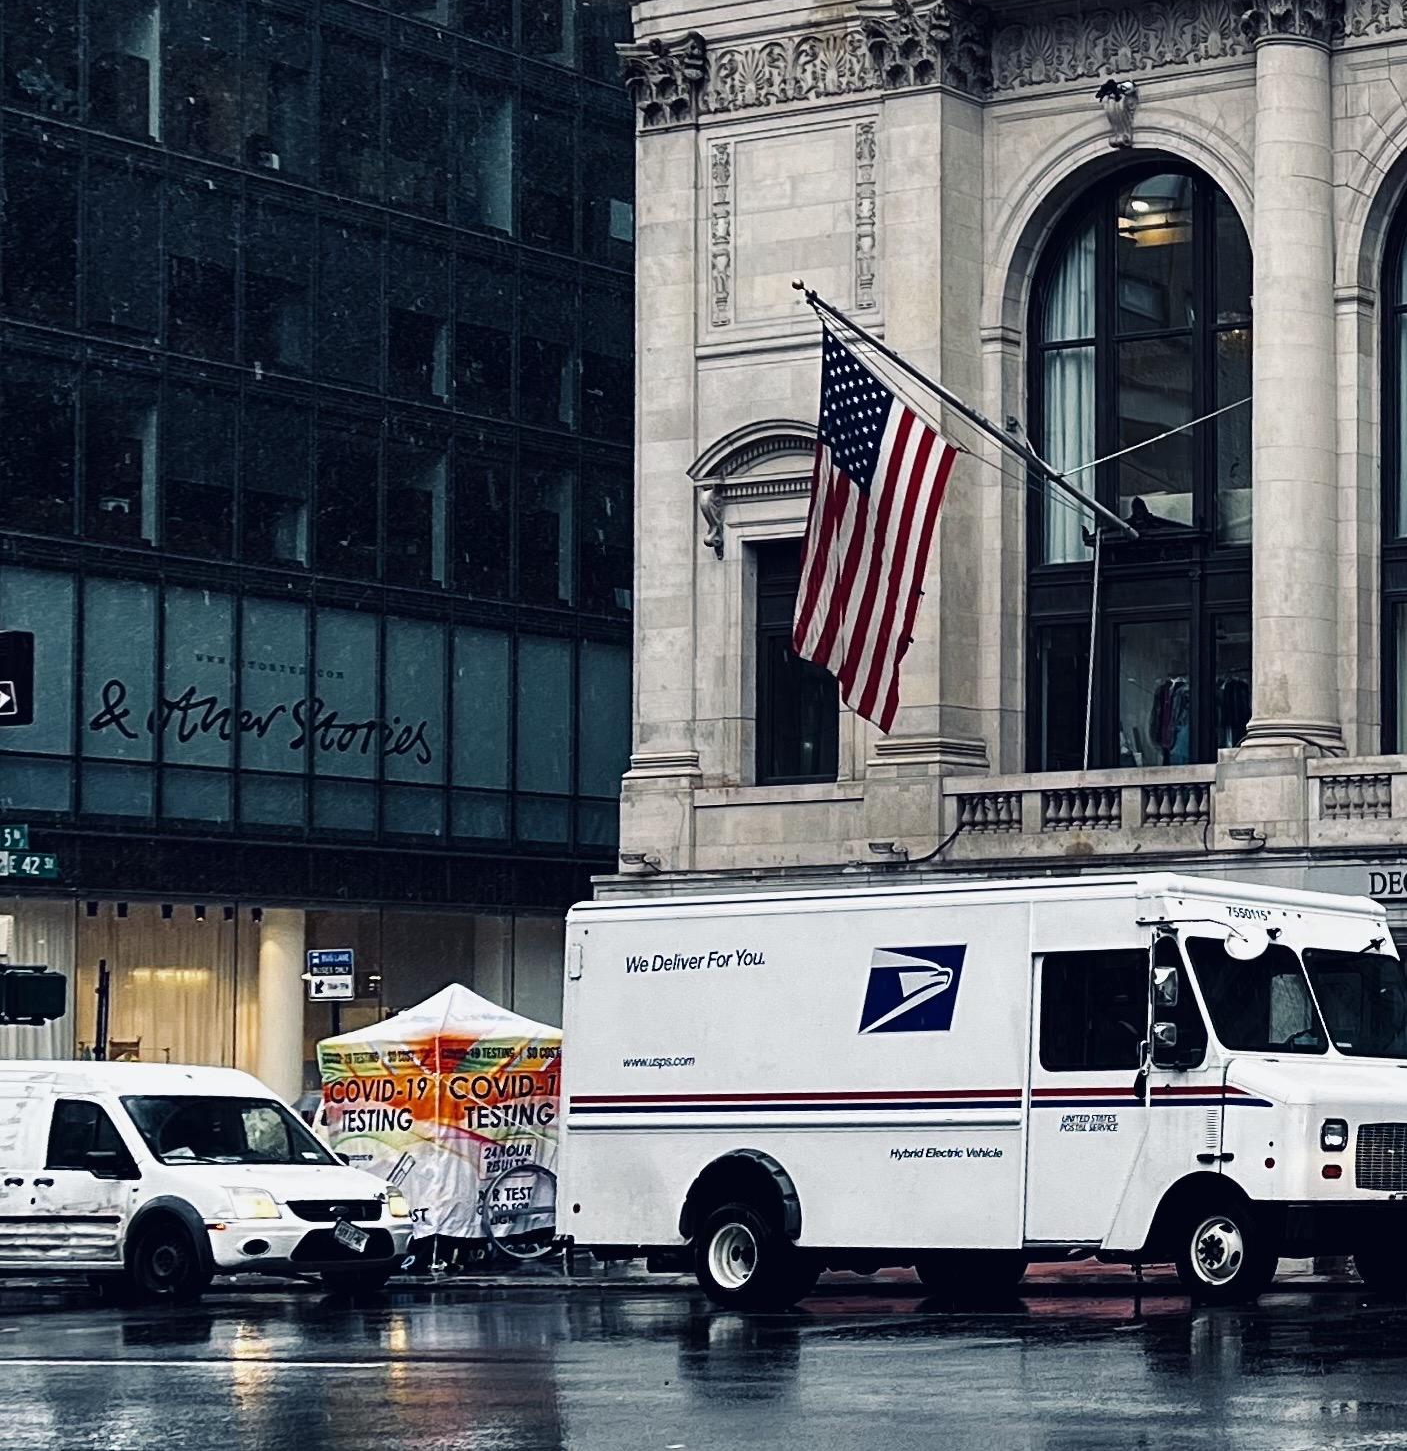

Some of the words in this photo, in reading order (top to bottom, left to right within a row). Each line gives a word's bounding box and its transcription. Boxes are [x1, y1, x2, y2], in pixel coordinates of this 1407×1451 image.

[89, 679, 139, 739] &
[288, 698, 432, 765] Stories
[21, 856, 40, 875] 42
[626, 956, 649, 974] We
[651, 953, 705, 972] Deliver
[706, 951, 733, 969] For
[735, 948, 766, 967] You.
[481, 1047, 515, 1059] TESTING
[623, 1056, 696, 1069] www.usps.com
[330, 1077, 428, 1104] COVID-19
[448, 1073, 557, 1100] COVID-1
[342, 1107, 413, 1132] TESTING
[463, 1102, 555, 1129] TESTING
[1061, 1114, 1091, 1123] UNITED
[1091, 1114, 1117, 1123] STATES
[1059, 1123, 1087, 1132] POSTAL
[1088, 1123, 1119, 1132] SERVICE
[483, 1146, 497, 1160] 24
[498, 1143, 532, 1159] HOUR
[890, 1148, 923, 1161] Hybrid
[925, 1148, 964, 1159] Electric
[966, 1148, 1003, 1159] Vehicle
[504, 1186, 533, 1201] TEST
